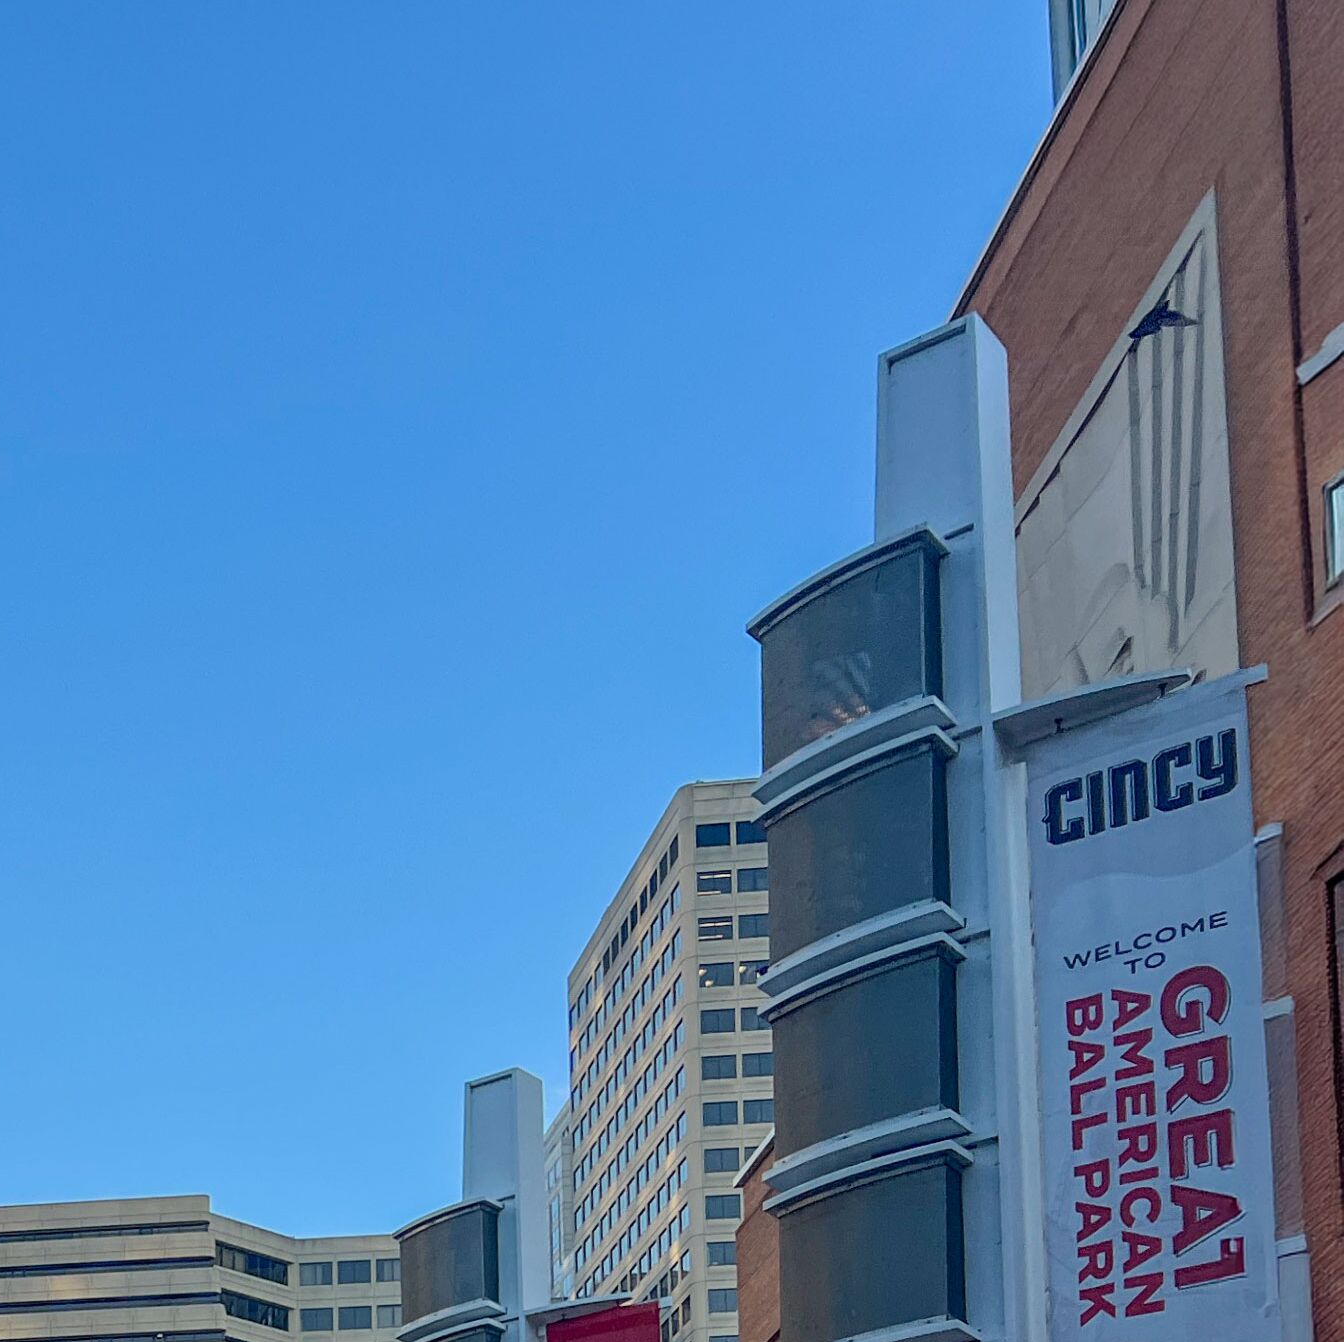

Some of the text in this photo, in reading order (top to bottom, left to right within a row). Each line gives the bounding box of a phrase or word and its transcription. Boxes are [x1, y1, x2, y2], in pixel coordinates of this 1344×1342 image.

[1042, 728, 1238, 845] CINCY
[1063, 911, 1229, 970] WELCOME
[1123, 951, 1166, 975] TO
[1110, 988, 1166, 1318] AMERICAN
[1160, 964, 1246, 1291] GREAT
